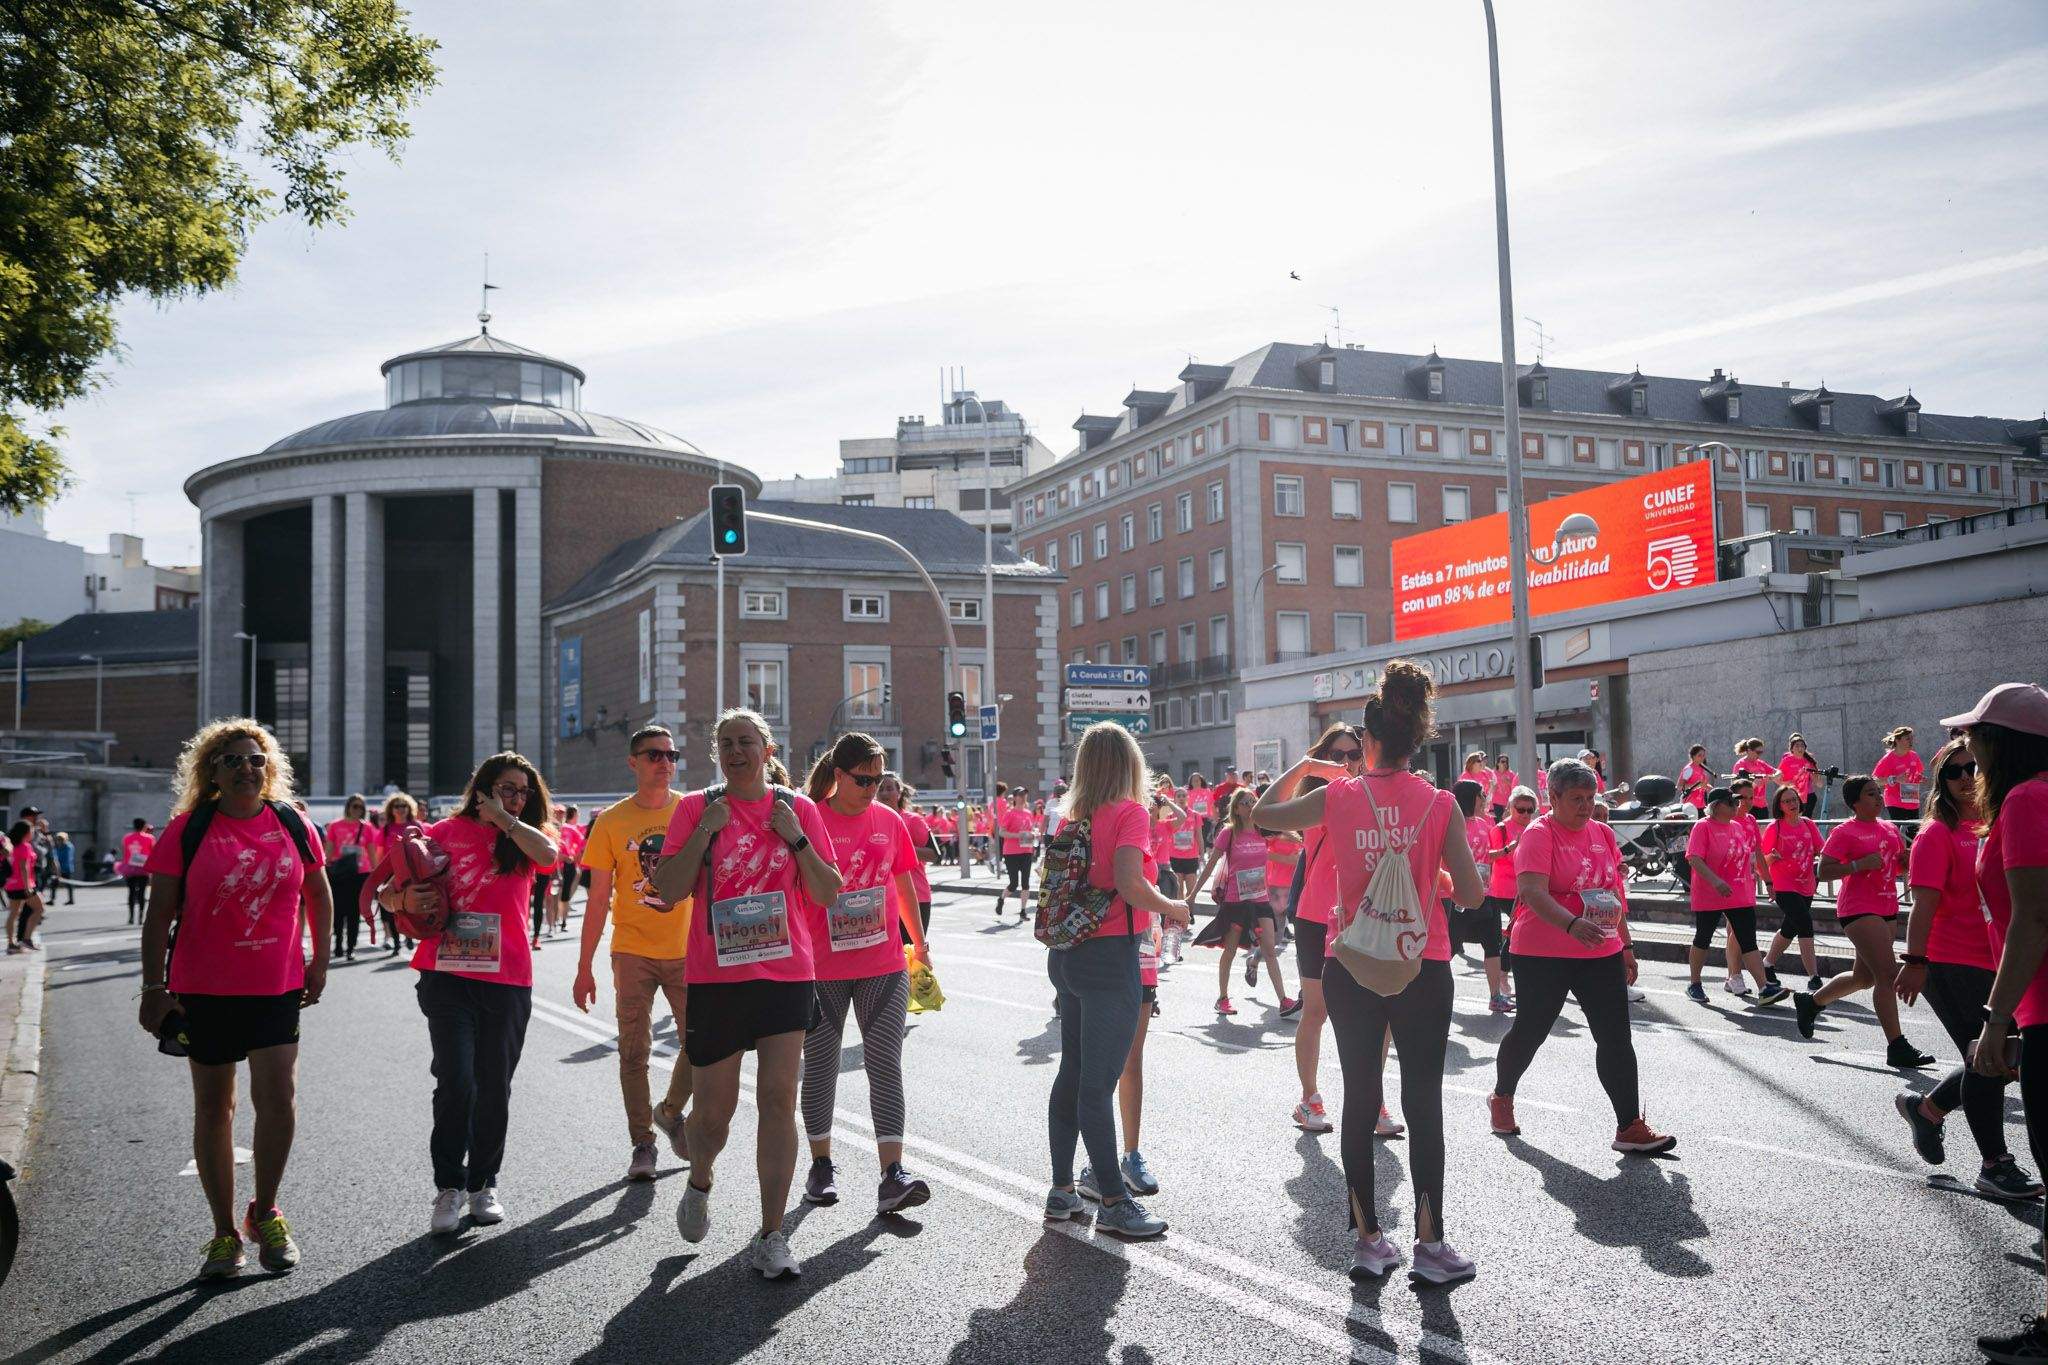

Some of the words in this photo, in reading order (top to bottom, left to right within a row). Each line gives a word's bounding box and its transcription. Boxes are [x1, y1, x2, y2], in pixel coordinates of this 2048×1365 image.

[1643, 483, 1695, 510] CUNEF
[1645, 502, 1695, 520] UNIVERSIDAD
[1401, 571, 1434, 592] Estás
[1436, 570, 1444, 583] a
[1445, 564, 1453, 581] 7
[1455, 555, 1508, 579] minutos
[1402, 599, 1425, 614] con
[1426, 593, 1443, 608] un
[1477, 580, 1495, 599] de
[1496, 554, 1611, 595] eleabilidad
[1071, 670, 1077, 679] A
[1079, 670, 1107, 679] Coruña
[981, 715, 997, 727] TAXI
[1376, 806, 1400, 827] TU
[850, 914, 873, 927] 016
[740, 923, 768, 938] 016
